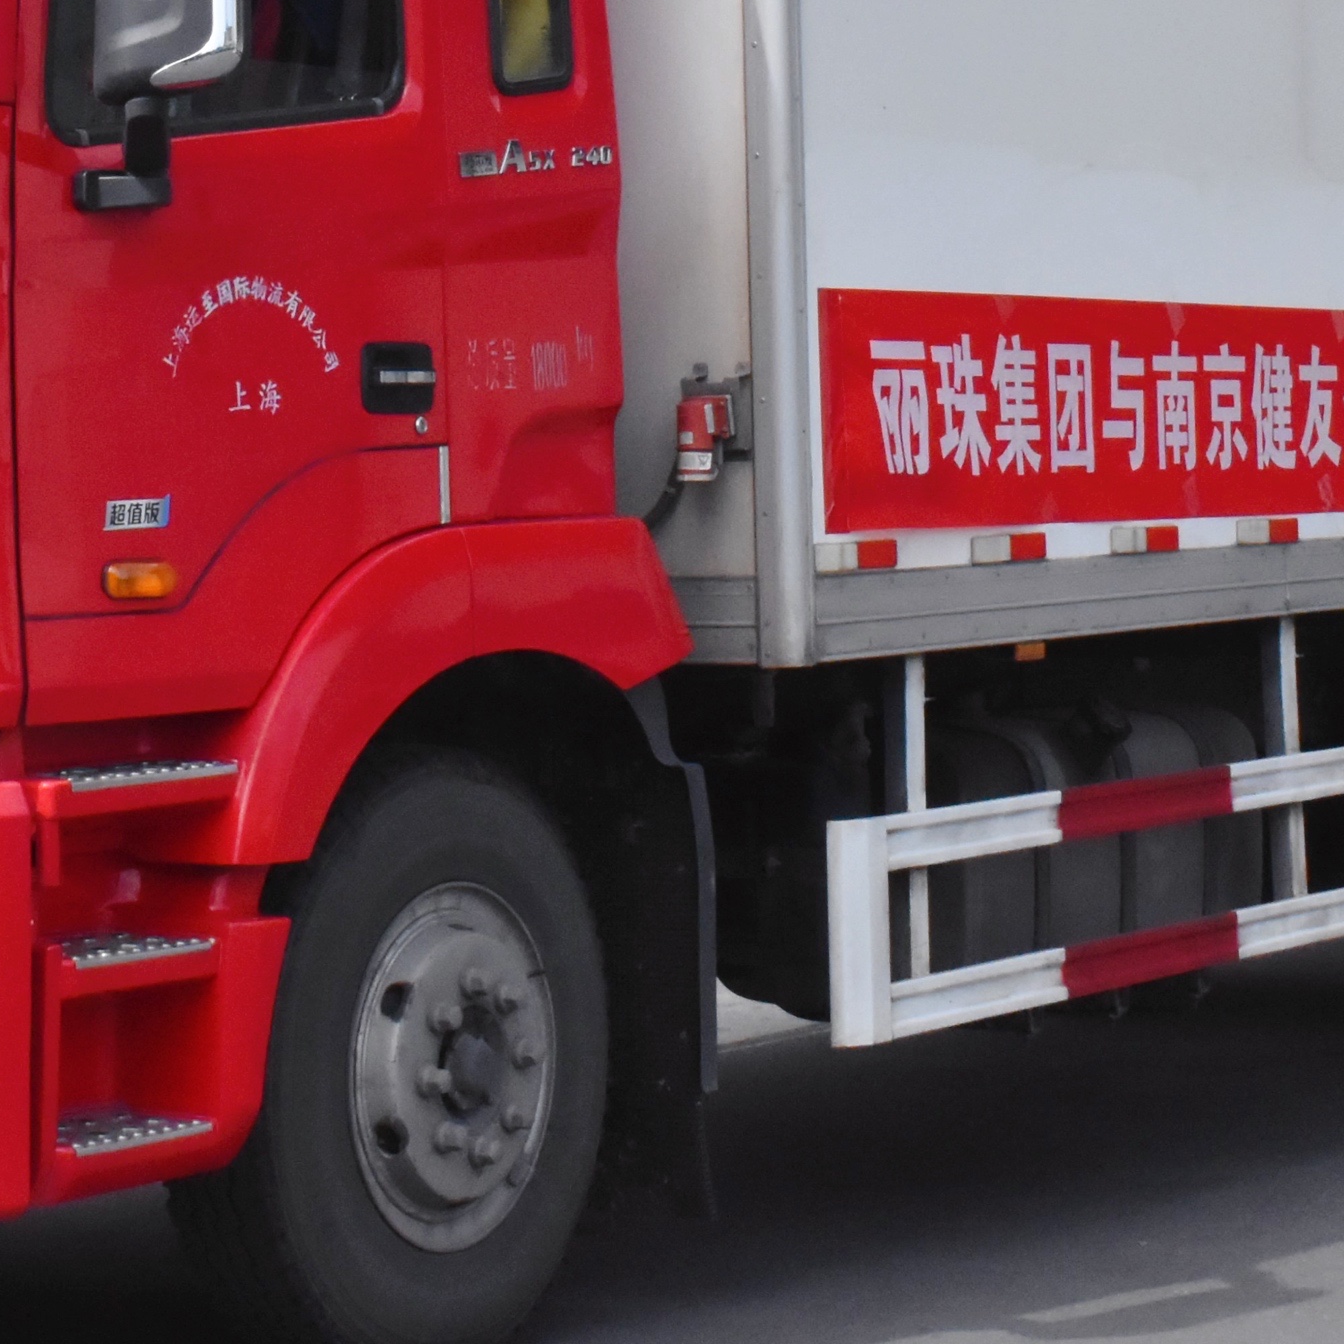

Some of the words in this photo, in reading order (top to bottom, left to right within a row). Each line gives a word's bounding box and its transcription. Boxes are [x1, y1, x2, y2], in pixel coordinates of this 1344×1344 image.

[571, 146, 613, 167] 240
[162, 276, 340, 378] 上海运至国际物流有限公司
[228, 380, 282, 416] 上海
[110, 502, 161, 526] 超值版
